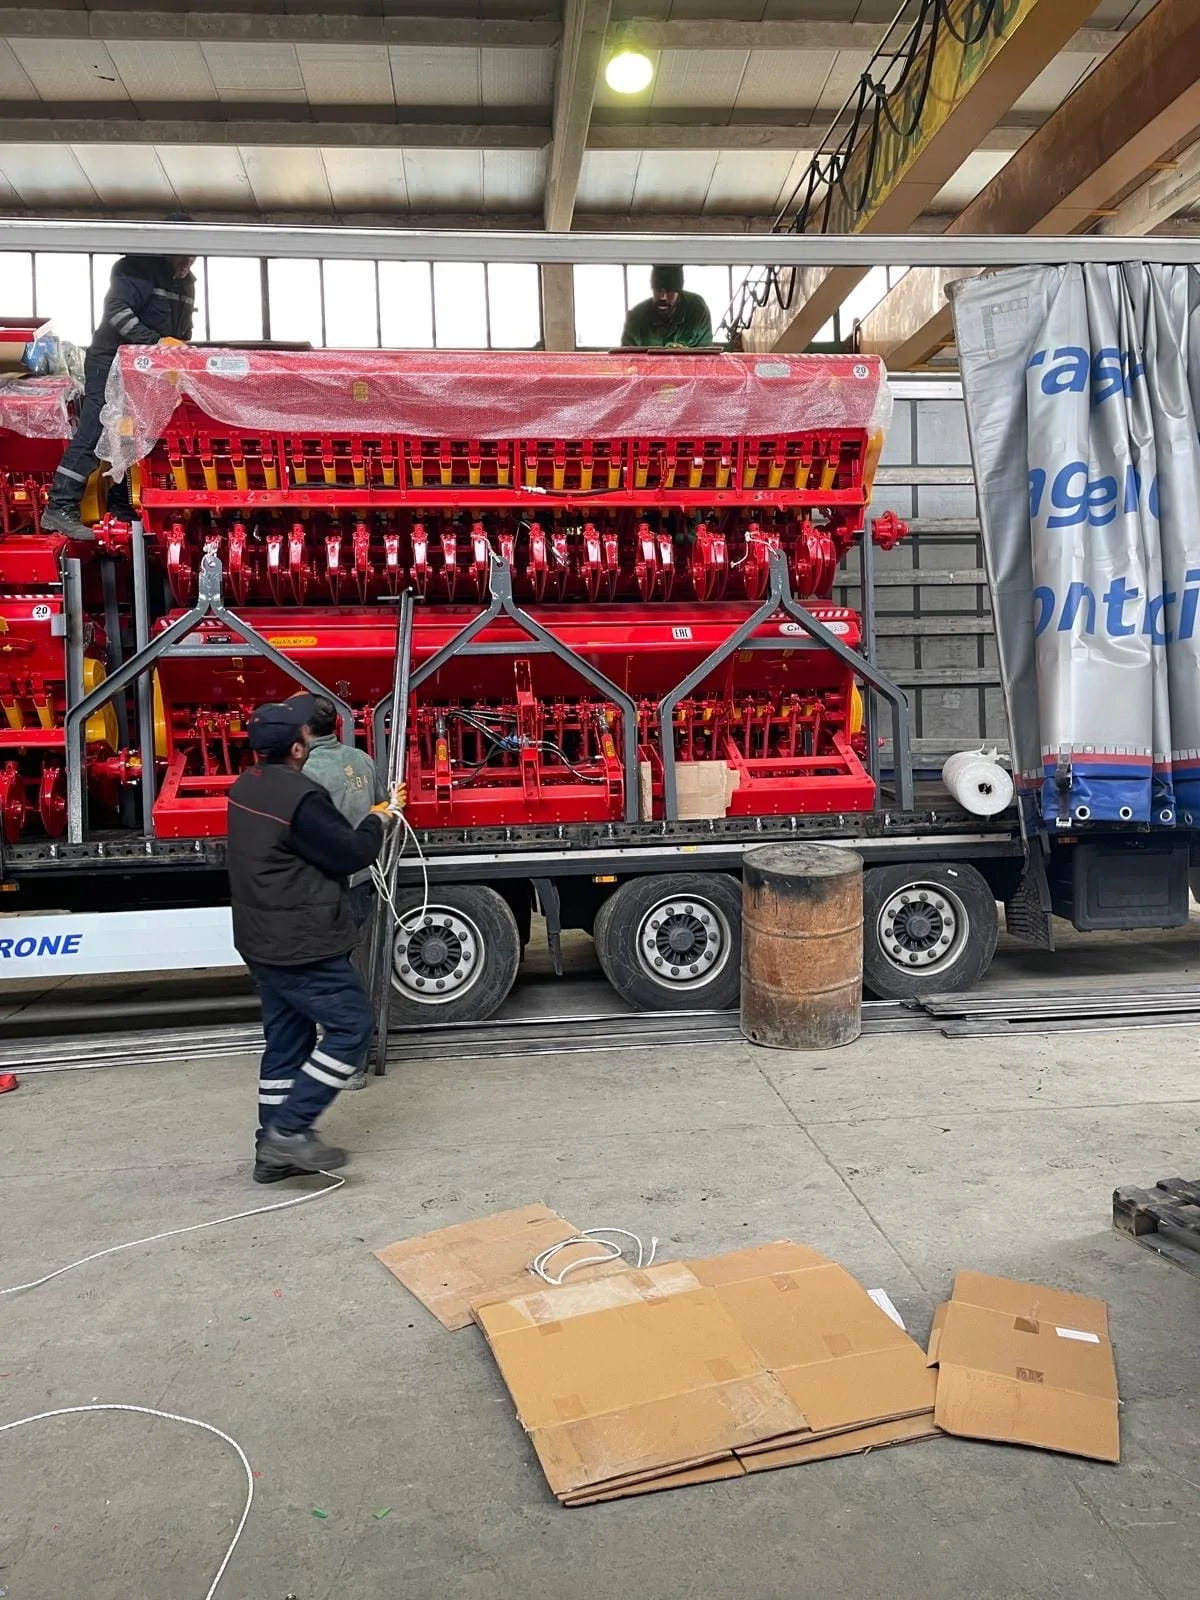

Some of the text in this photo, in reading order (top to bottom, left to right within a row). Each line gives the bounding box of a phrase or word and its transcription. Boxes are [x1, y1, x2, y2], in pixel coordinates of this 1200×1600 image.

[137, 358, 149, 366] 20
[856, 366, 866, 374] 20
[36, 606, 48, 615] 20
